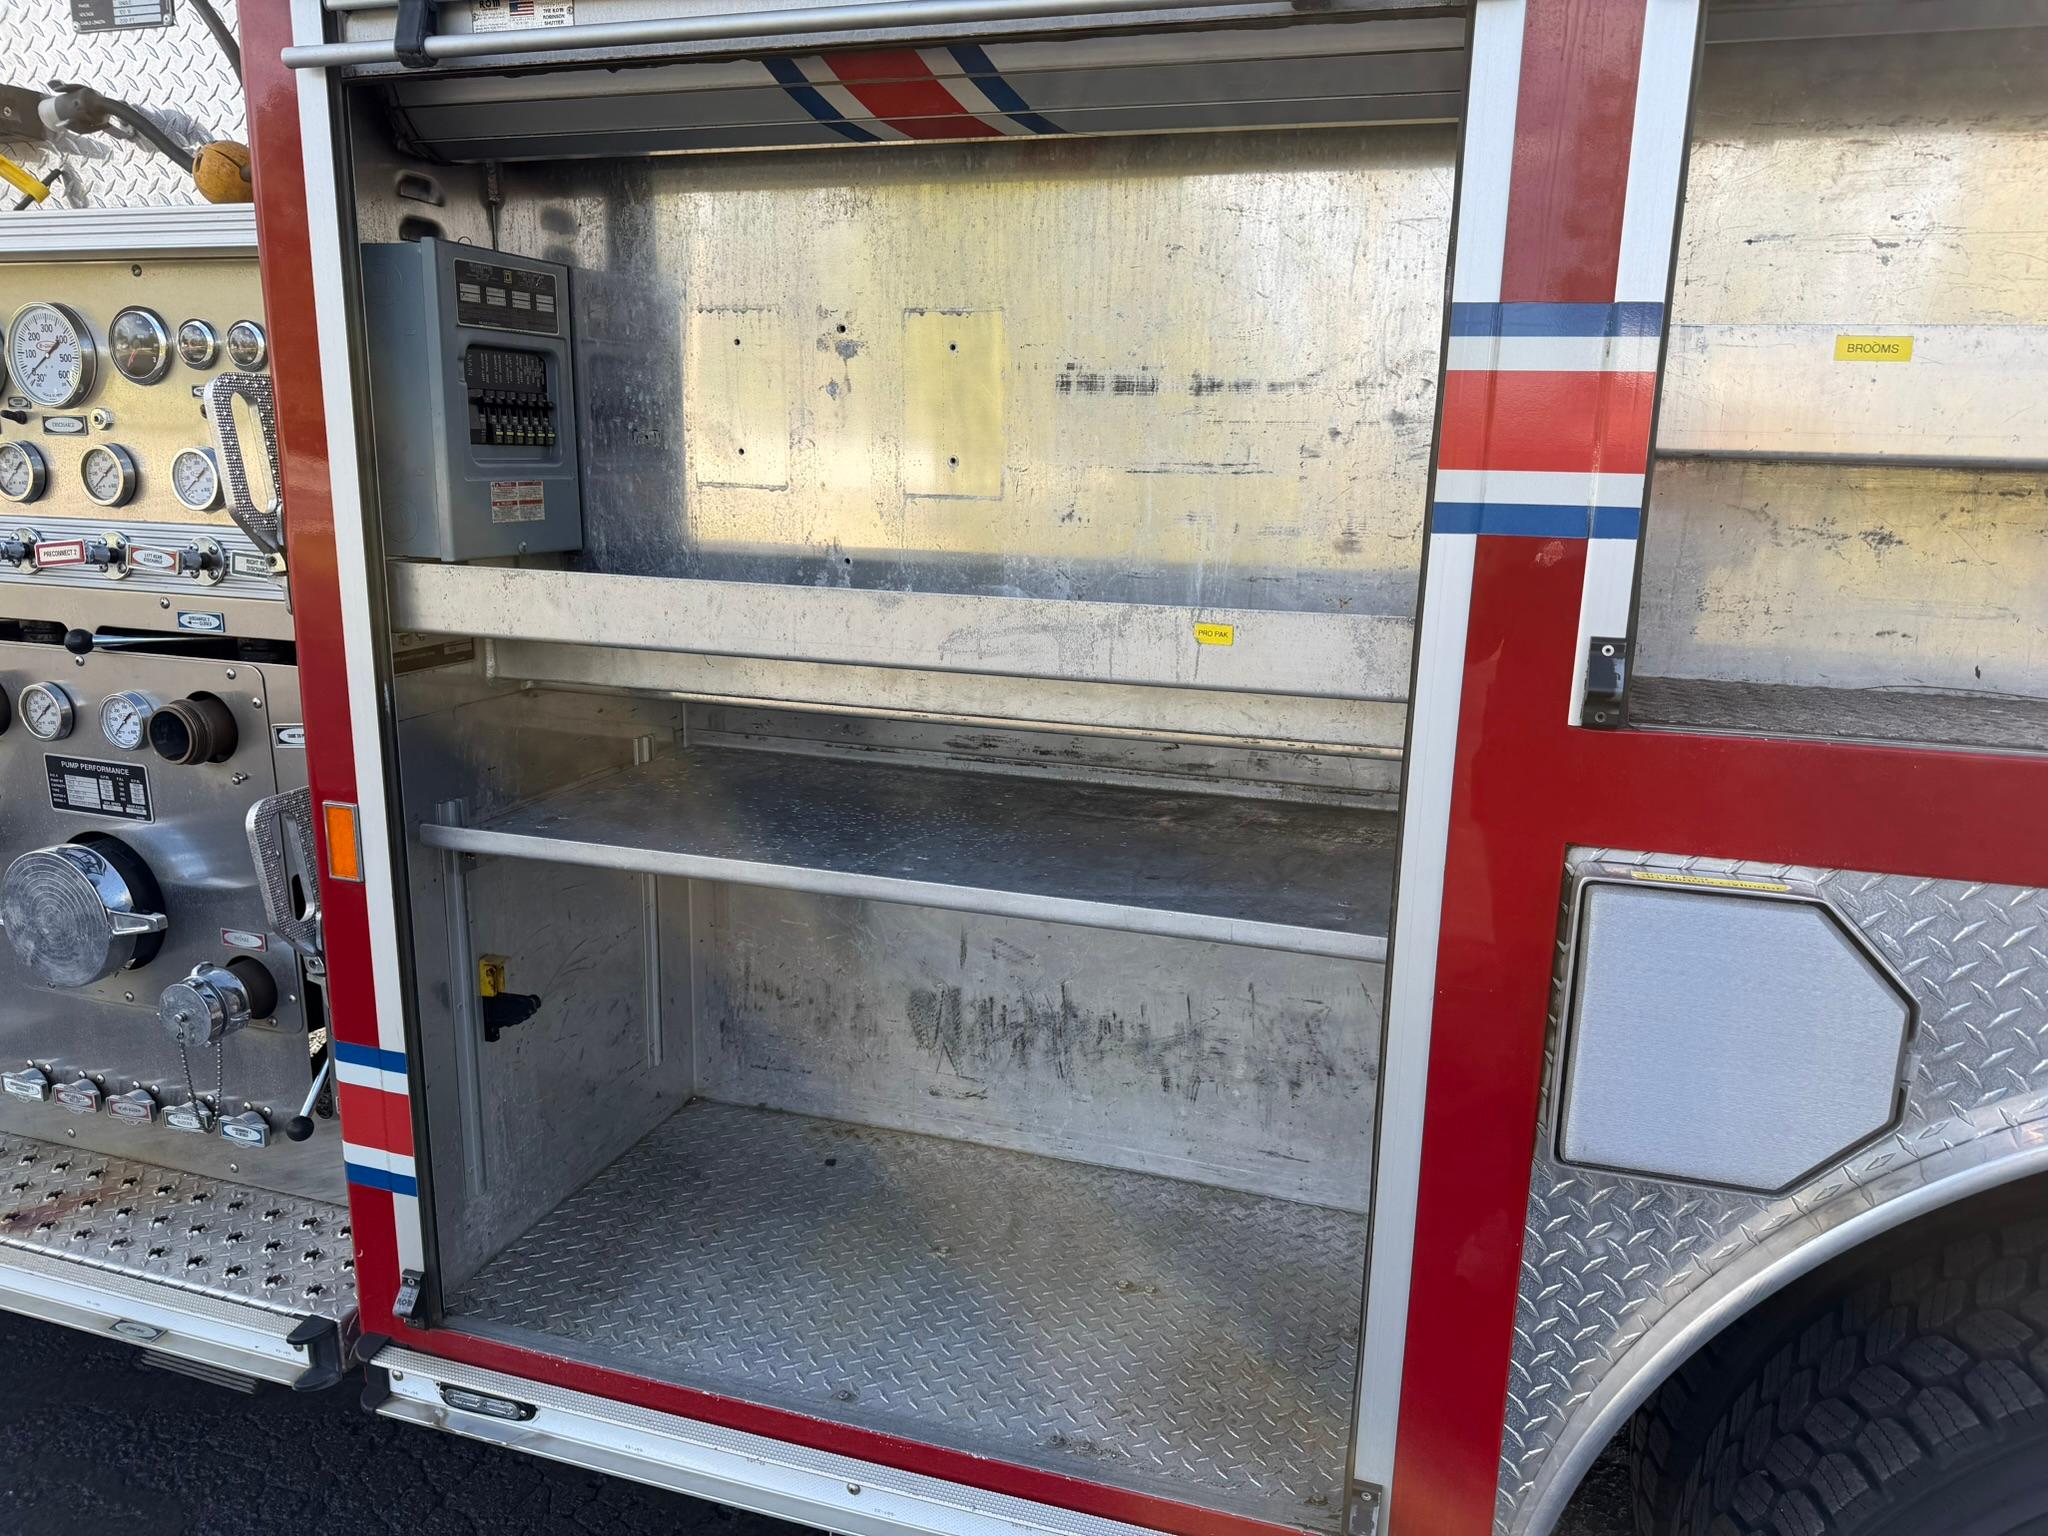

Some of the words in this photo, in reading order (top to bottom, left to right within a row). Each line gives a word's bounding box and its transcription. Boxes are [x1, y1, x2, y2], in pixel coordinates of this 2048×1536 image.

[40, 323, 53, 333] 300
[28, 332, 41, 341] 200
[1846, 343, 1900, 354] BROOMS
[25, 349, 37, 358] 100
[59, 353, 73, 363] 500
[58, 370, 71, 379] 600
[43, 549, 73, 557] PRECONNECT
[1198, 629, 1214, 637] PRO
[1214, 630, 1229, 638] PAK
[61, 760, 79, 769] PUMP
[80, 762, 130, 776] PERFORMANCE
